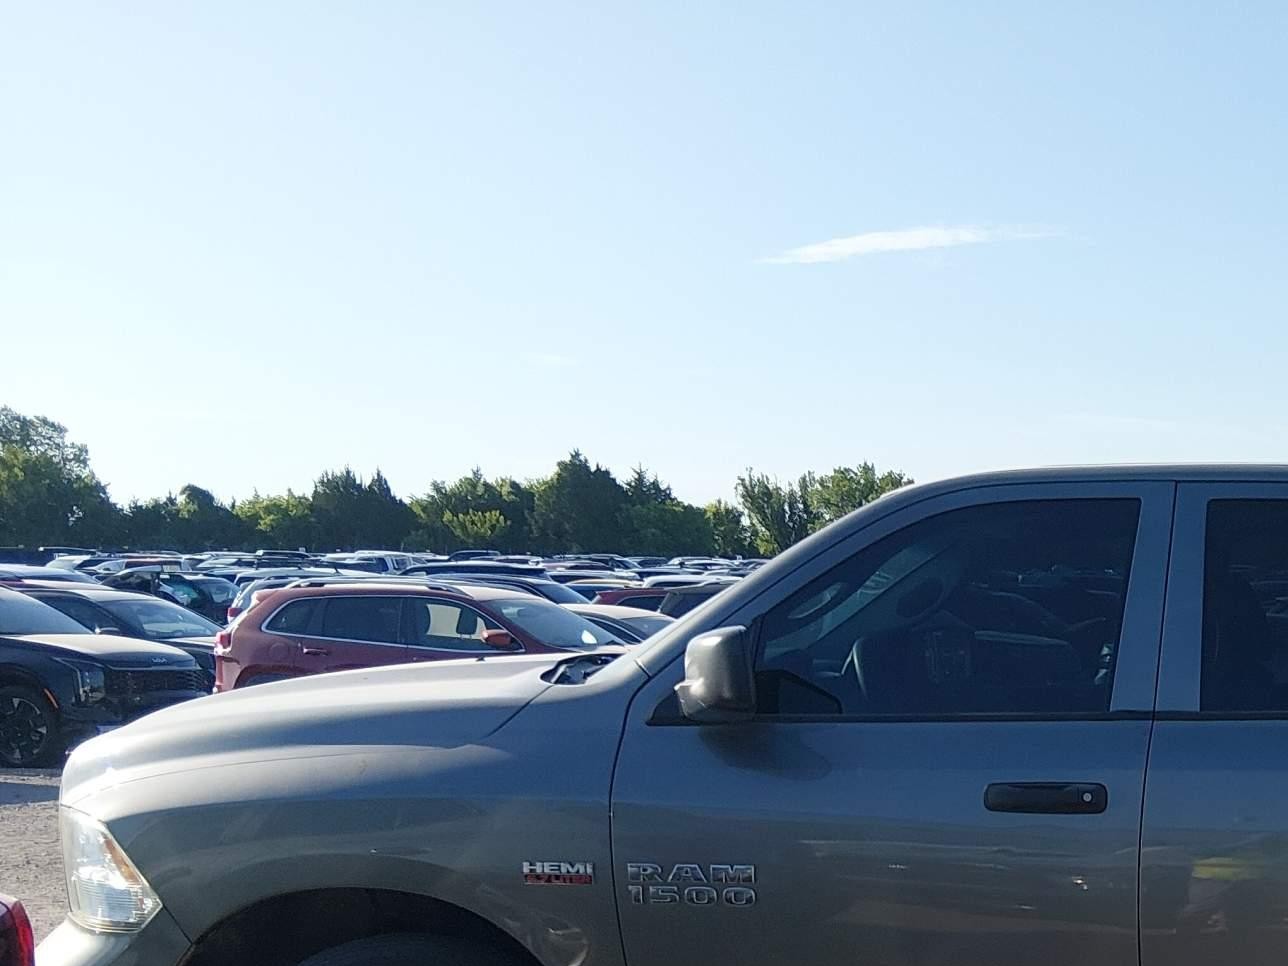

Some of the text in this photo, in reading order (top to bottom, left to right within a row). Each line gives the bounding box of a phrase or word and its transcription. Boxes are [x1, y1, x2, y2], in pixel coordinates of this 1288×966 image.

[522, 862, 593, 874] HEMI
[627, 863, 755, 883] RAM
[627, 885, 756, 906] 1500
